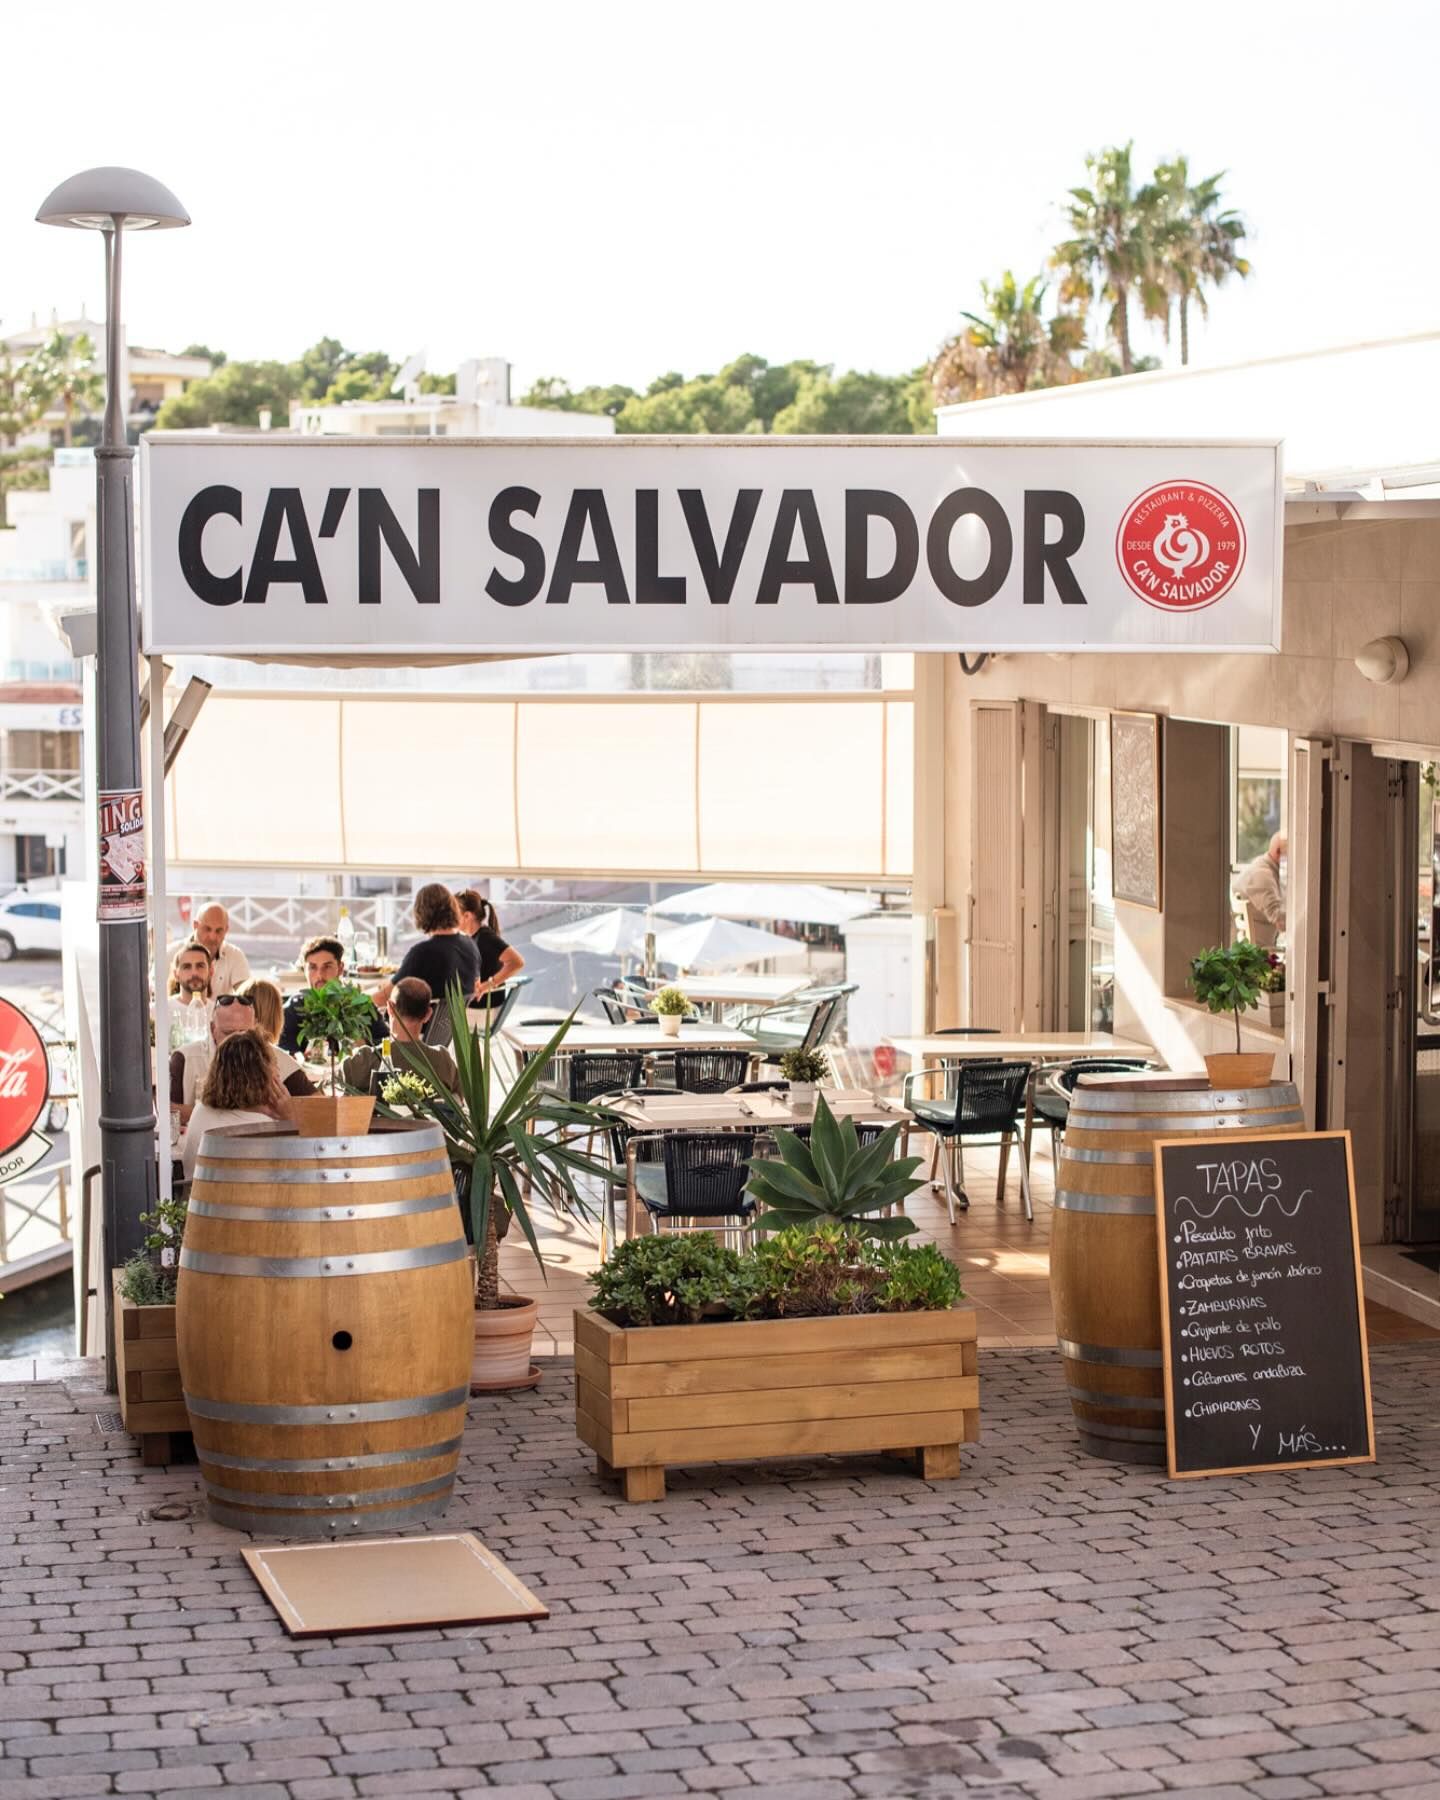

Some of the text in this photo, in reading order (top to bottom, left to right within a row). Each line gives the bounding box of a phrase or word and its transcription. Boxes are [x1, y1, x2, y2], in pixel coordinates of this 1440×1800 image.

[1133, 490, 1230, 528] RESTAURANT & PIZZERIA
[484, 484, 1088, 607] SALVADOR
[1126, 540, 1236, 551] DESDE 1979
[1160, 561, 1230, 600] SALVADOR
[1196, 1158, 1282, 1194] TAPAS
[1180, 1219, 1272, 1248] Pescadito frito
[1180, 1242, 1296, 1268] PATATAS BRAVAS
[1182, 1274, 1233, 1291] Croquetas
[1236, 1269, 1249, 1283] de
[1251, 1266, 1282, 1288] jamón
[1236, 1319, 1251, 1333] de
[1254, 1316, 1281, 1335] pollo
[1190, 1341, 1285, 1362] HUEVOS ROTOS
[1192, 1364, 1306, 1387] Calamares andaluza
